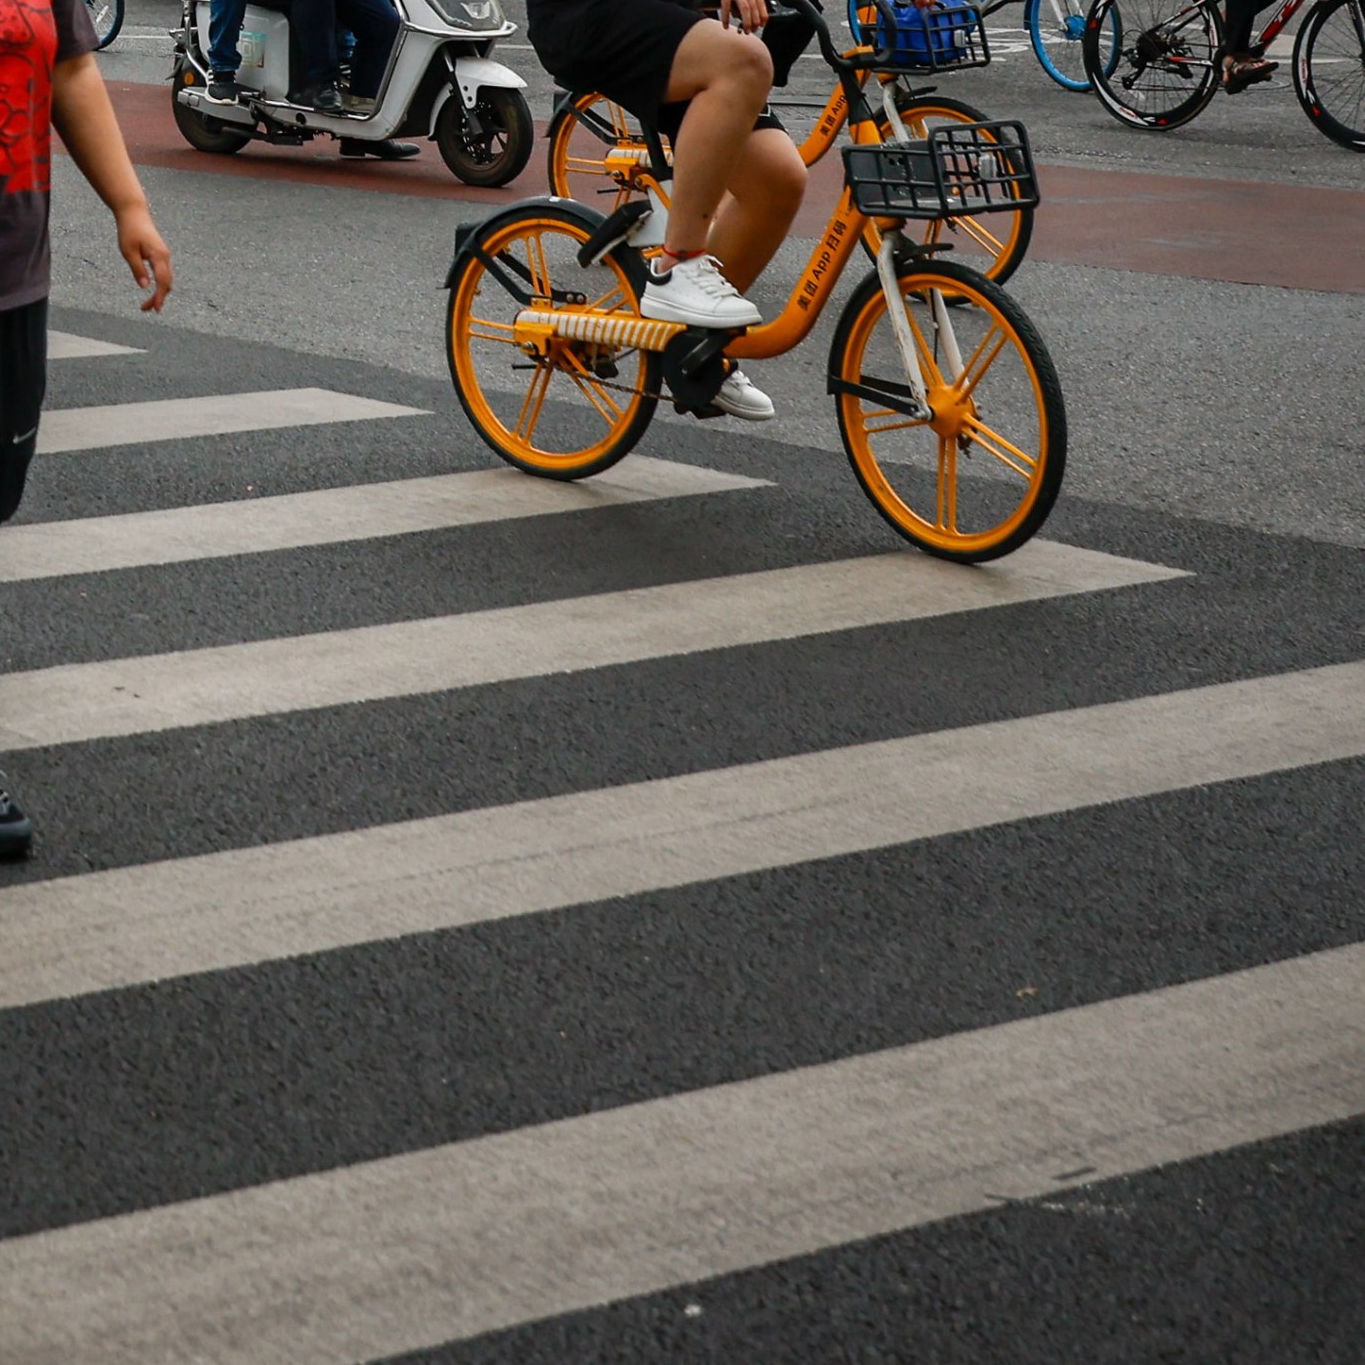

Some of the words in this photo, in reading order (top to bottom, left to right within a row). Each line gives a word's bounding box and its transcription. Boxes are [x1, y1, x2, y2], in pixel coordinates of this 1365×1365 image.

[797, 280, 819, 312] 美团
[812, 252, 831, 281] App
[826, 220, 847, 252] 扫码
